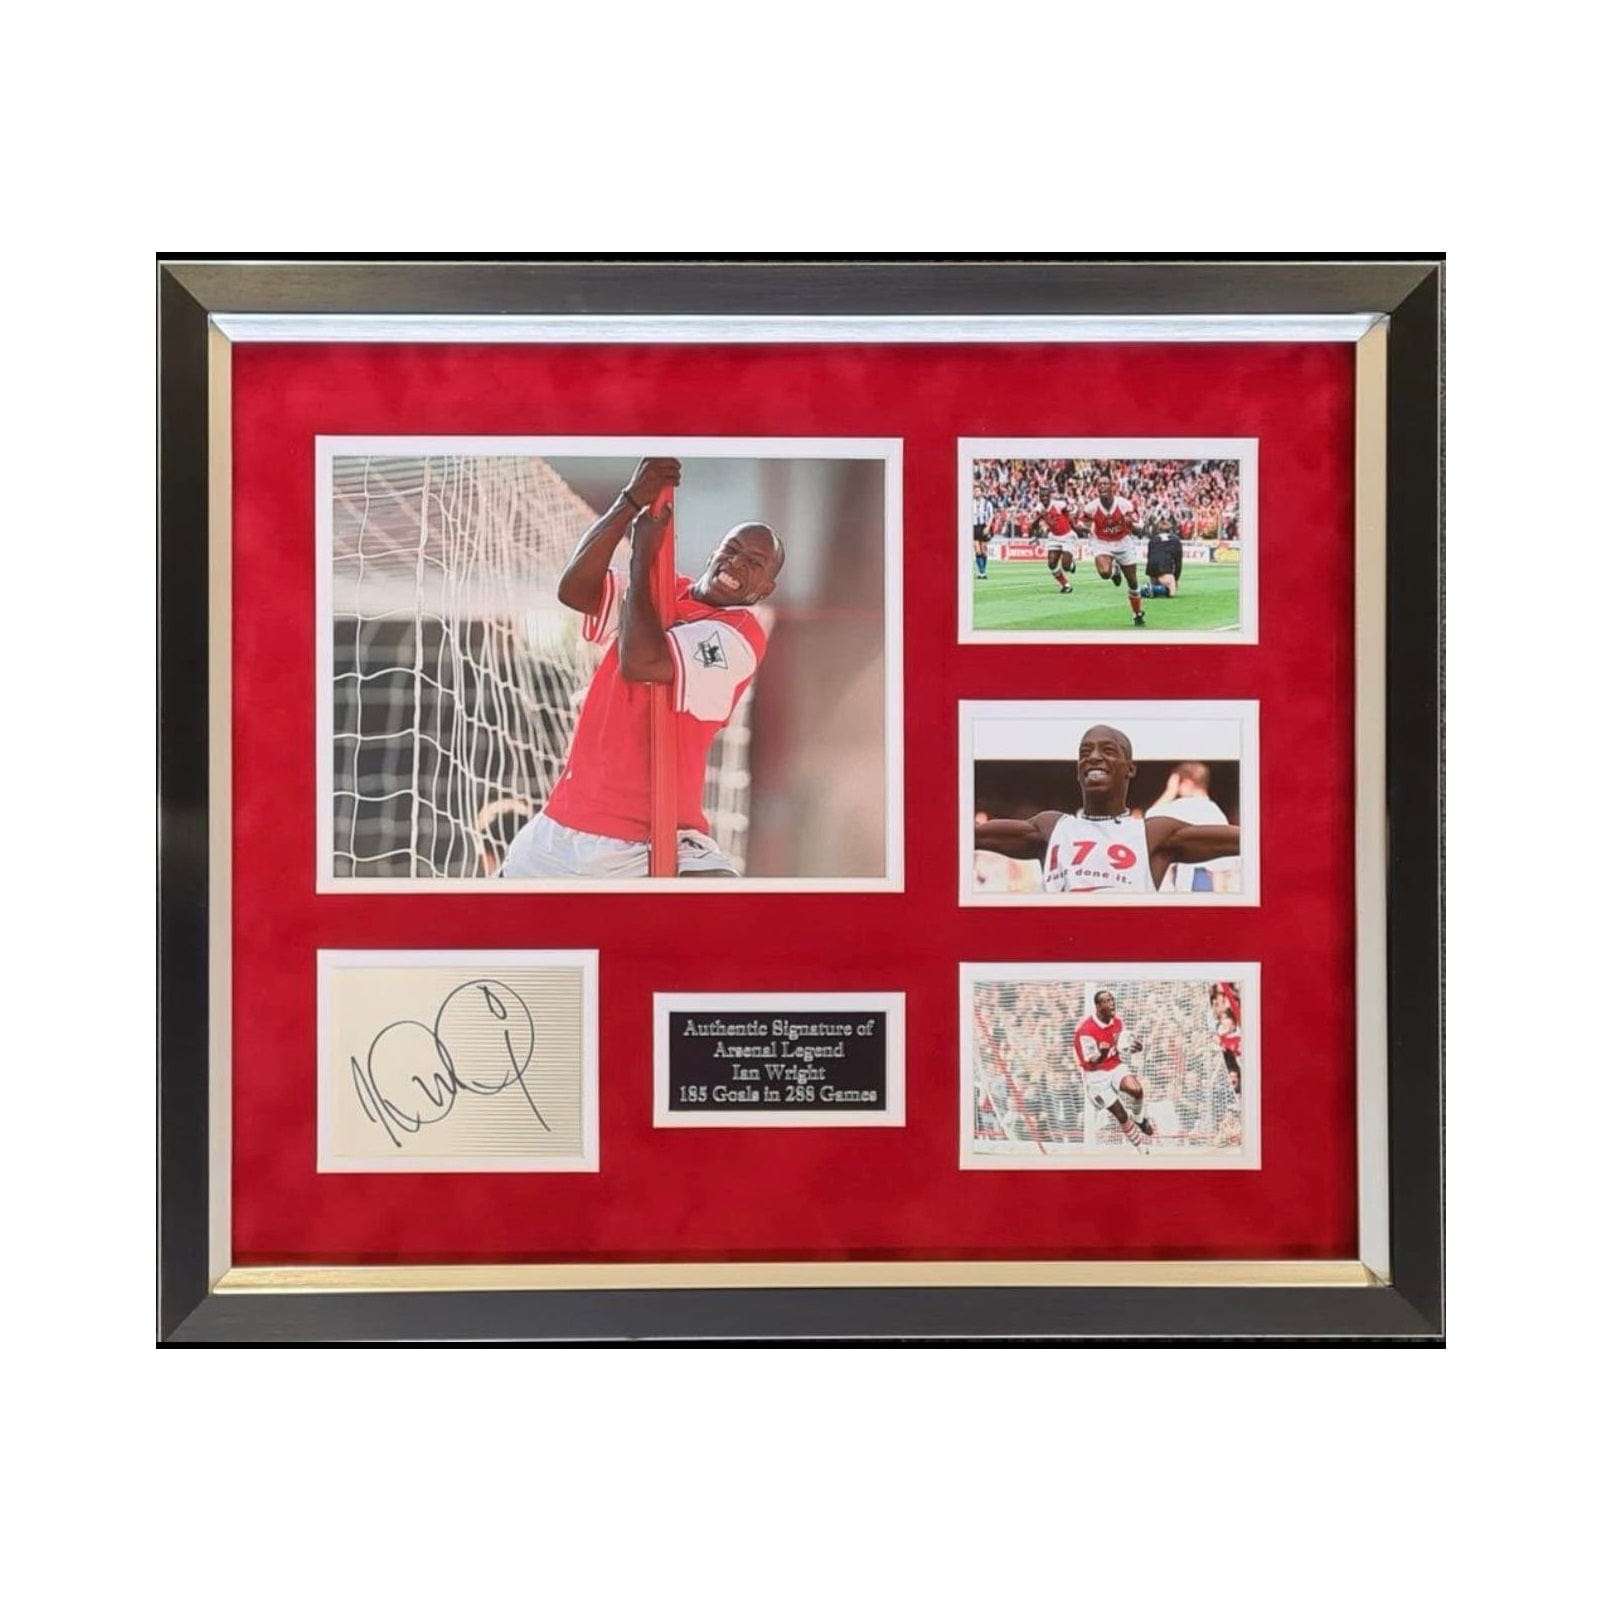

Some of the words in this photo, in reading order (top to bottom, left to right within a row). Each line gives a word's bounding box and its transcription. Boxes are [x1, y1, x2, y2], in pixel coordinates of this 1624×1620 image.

[1049, 841, 1137, 871] 179
[1075, 868, 1110, 879] done
[684, 1020, 767, 1036] Authentic
[772, 1020, 852, 1040] Signature
[857, 1020, 875, 1036] of
[713, 1041, 777, 1058] Arsenal
[781, 1041, 844, 1062] Legend
[732, 1064, 760, 1080] Ian
[764, 1064, 825, 1085] Wright
[680, 1086, 707, 1102] 185
[713, 1086, 759, 1102] Goals
[764, 1086, 781, 1101] in
[785, 1086, 815, 1102] 288
[820, 1086, 877, 1102] Games
